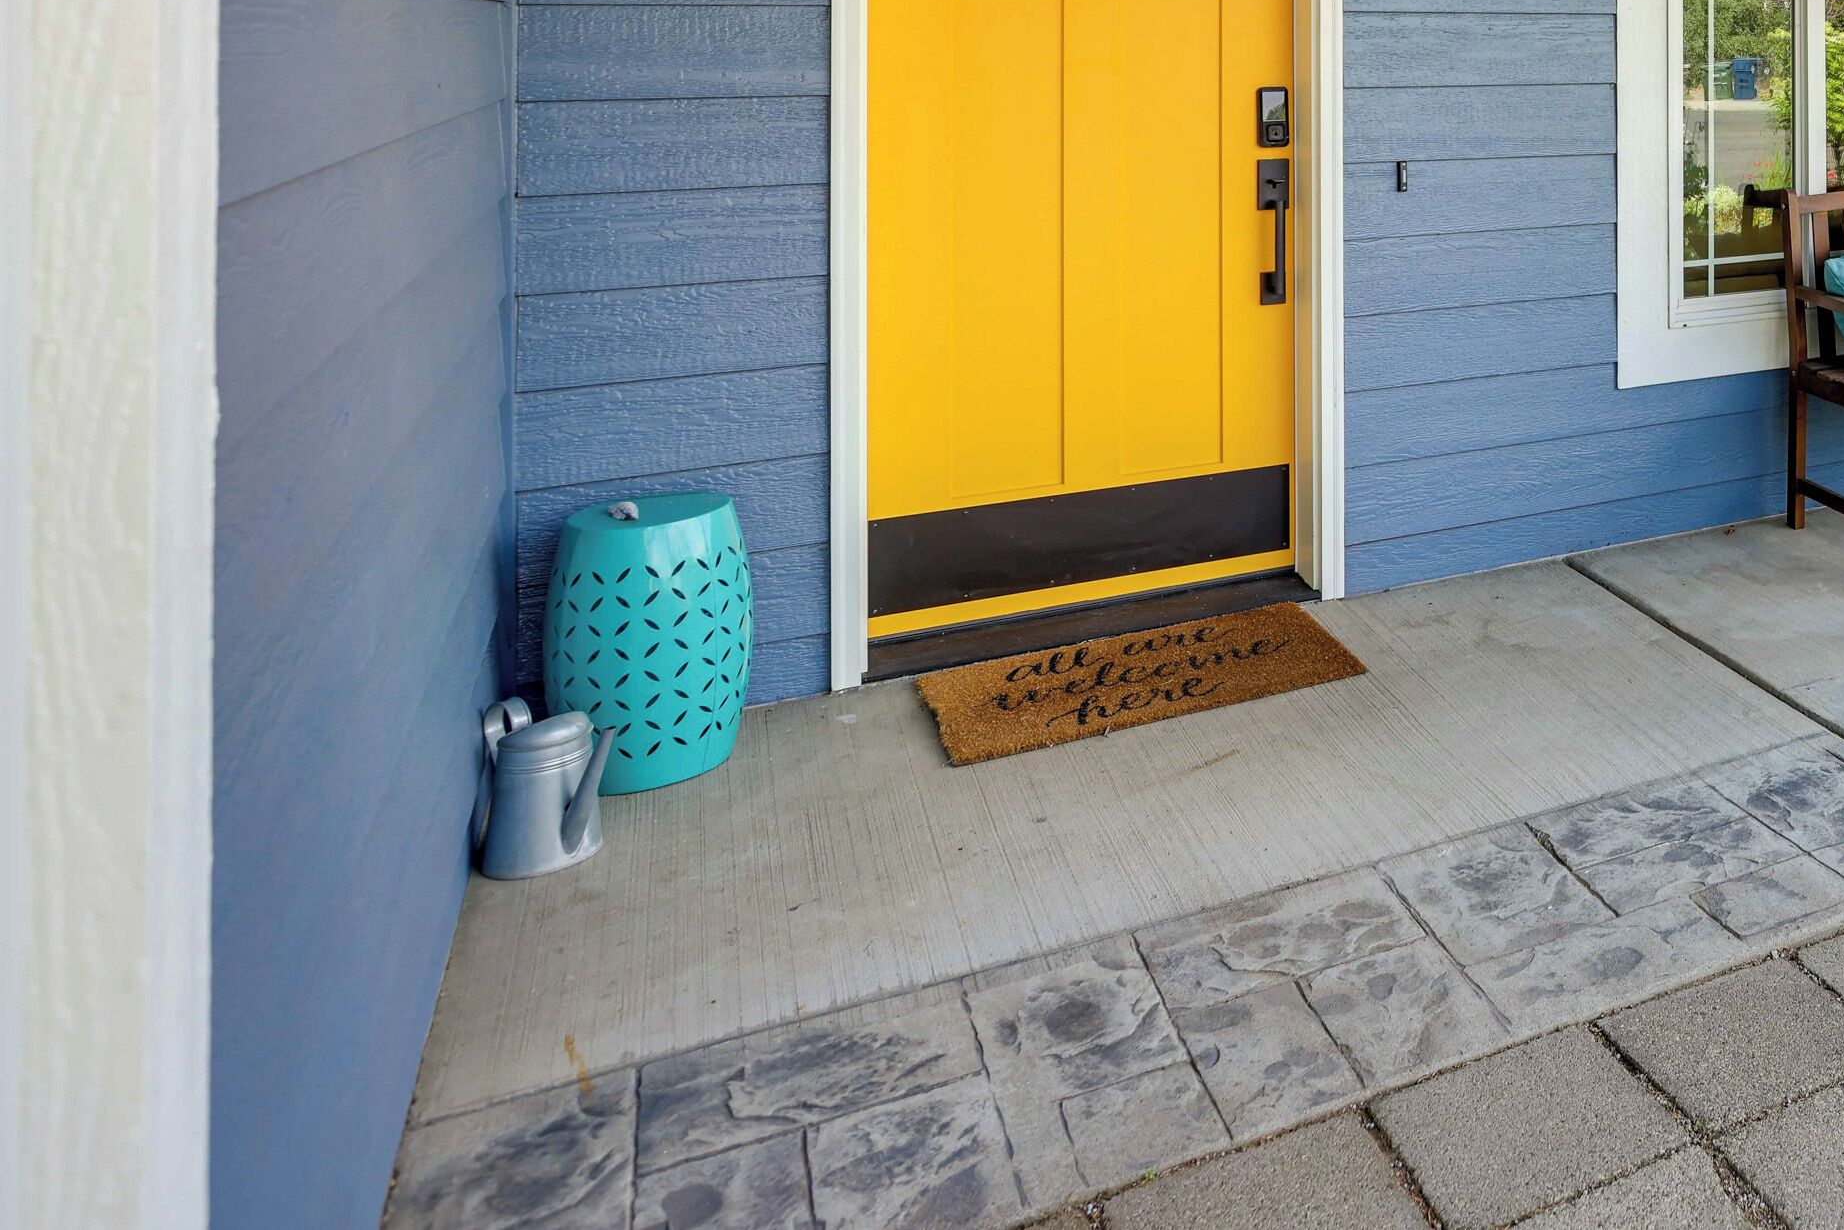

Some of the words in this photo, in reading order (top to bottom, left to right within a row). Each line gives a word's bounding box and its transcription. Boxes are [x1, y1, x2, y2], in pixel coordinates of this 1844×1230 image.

[979, 636, 1291, 711] welcome
[1005, 646, 1102, 682] all
[1123, 626, 1230, 657] are
[1044, 678, 1225, 727] here
